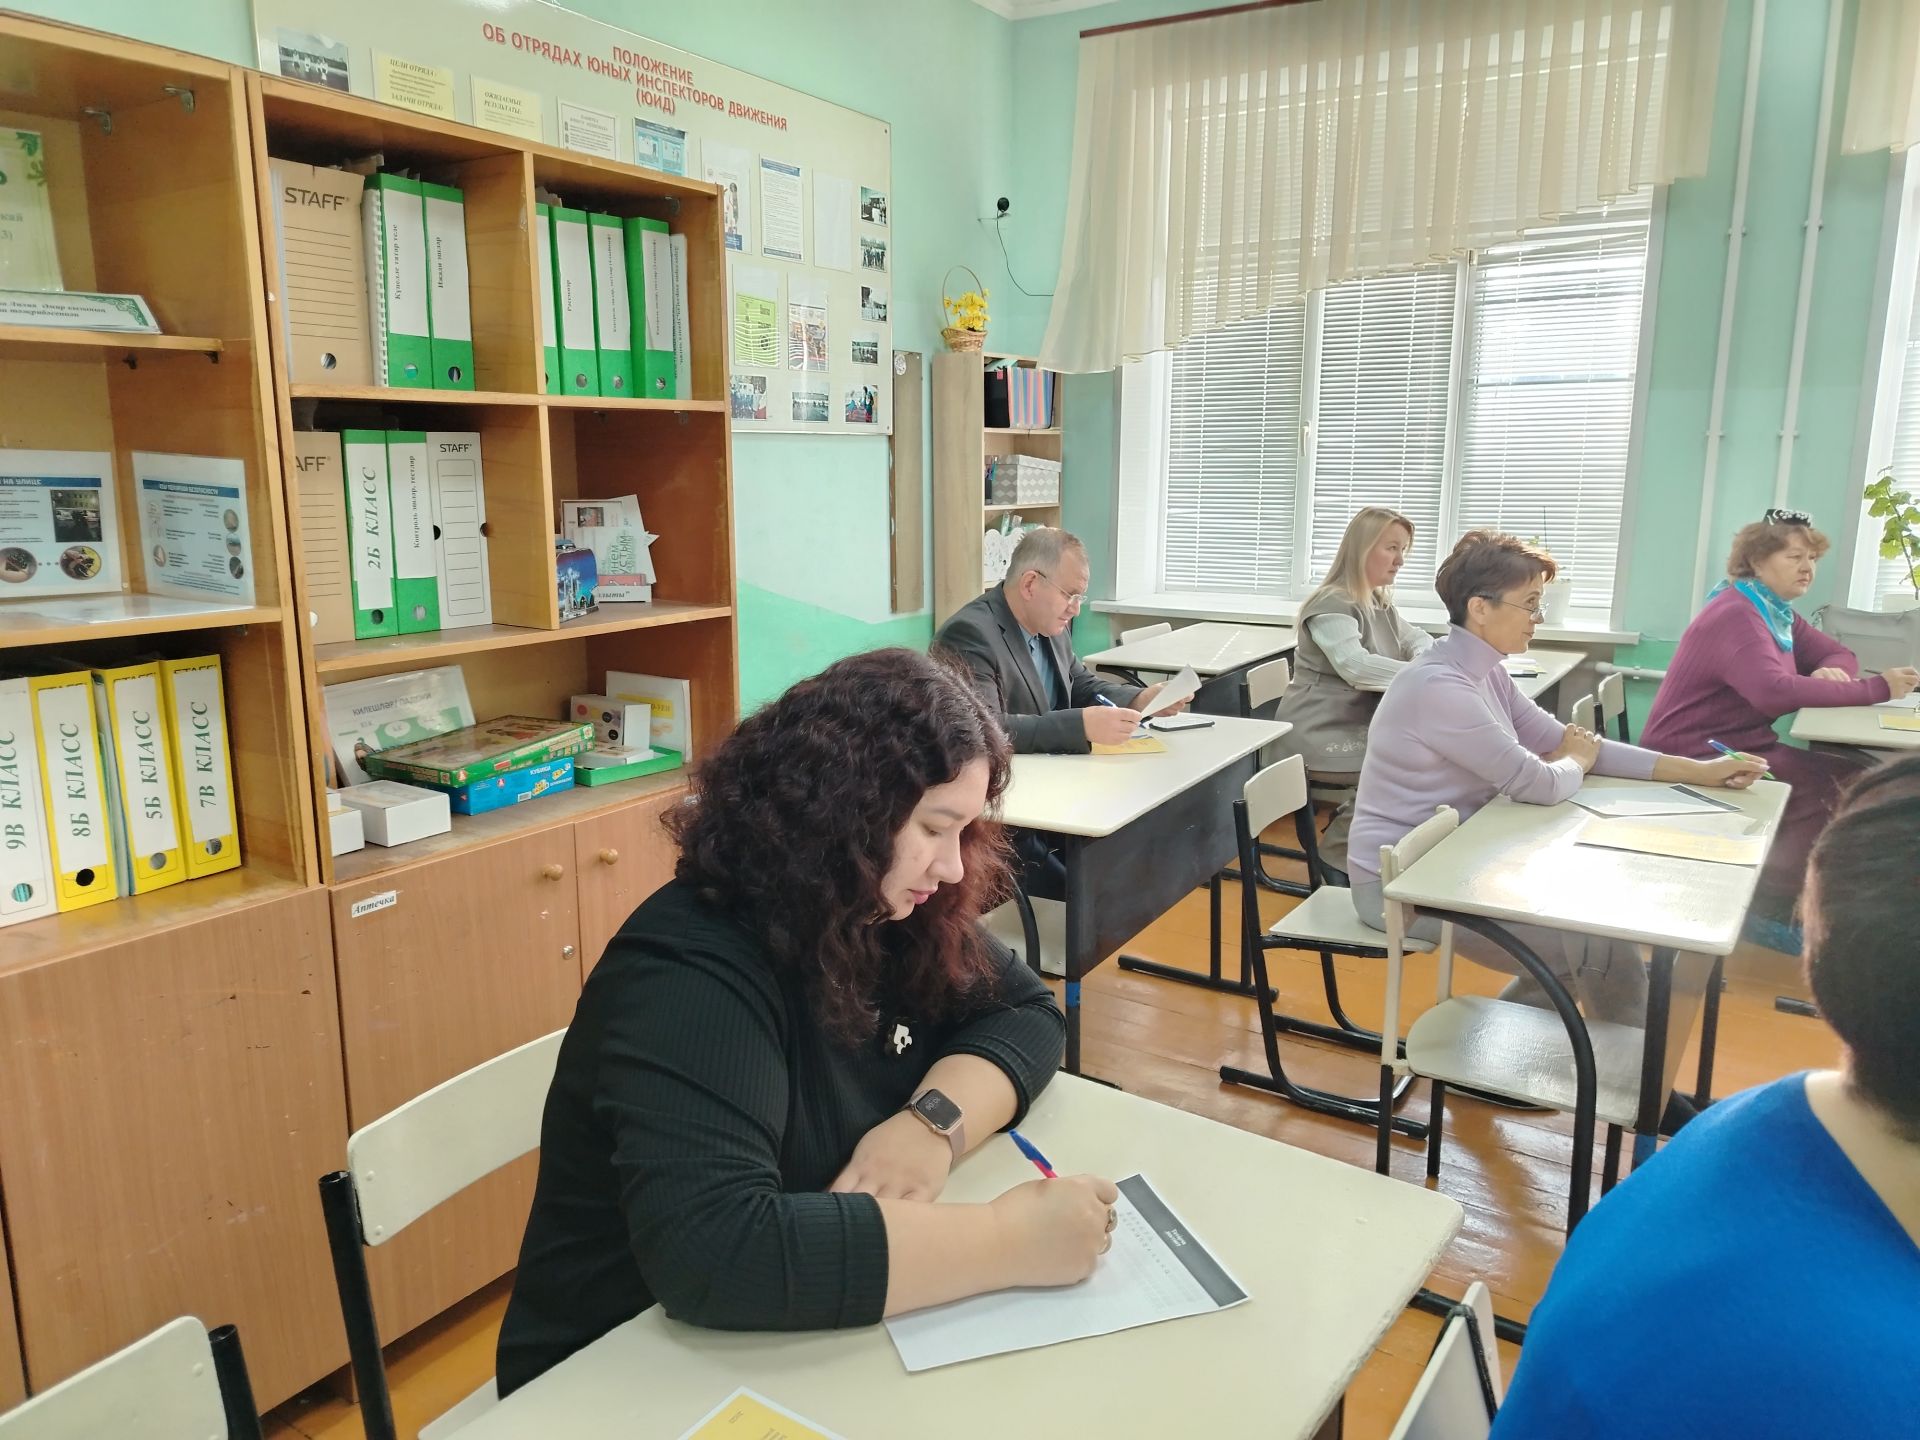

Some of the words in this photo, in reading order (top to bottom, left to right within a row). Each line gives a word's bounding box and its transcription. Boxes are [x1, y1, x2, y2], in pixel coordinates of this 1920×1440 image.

[390, 58, 408, 68] ЦЕЛИ
[613, 46, 694, 86] ПОЛОЖЕНИЕ
[482, 22, 505, 43] ОБ
[511, 32, 582, 68] ОТРЯДАХ
[587, 55, 631, 83] ЮНЫХ
[636, 71, 724, 111] ИНСПЕКТОРОВ
[728, 100, 788, 132] ДВИЖЕНИЯ
[391, 93, 416, 105] ЗАДАЧИ
[636, 89, 675, 115] (ЮИД)
[284, 186, 345, 211] STAFF
[440, 444, 469, 453] STAFF
[362, 466, 380, 536] КЛАСС
[366, 545, 382, 570] 2Б
[134, 709, 159, 785] КЛАСС
[191, 701, 214, 775] КЛАСС
[1, 730, 21, 811] КЛАСС
[59, 722, 85, 801] КЛАСС
[145, 795, 163, 820] 5Б
[199, 783, 218, 809] 7В
[6, 820, 26, 850] 9В
[71, 813, 92, 838] 8Б
[352, 895, 396, 916] Аптечка
